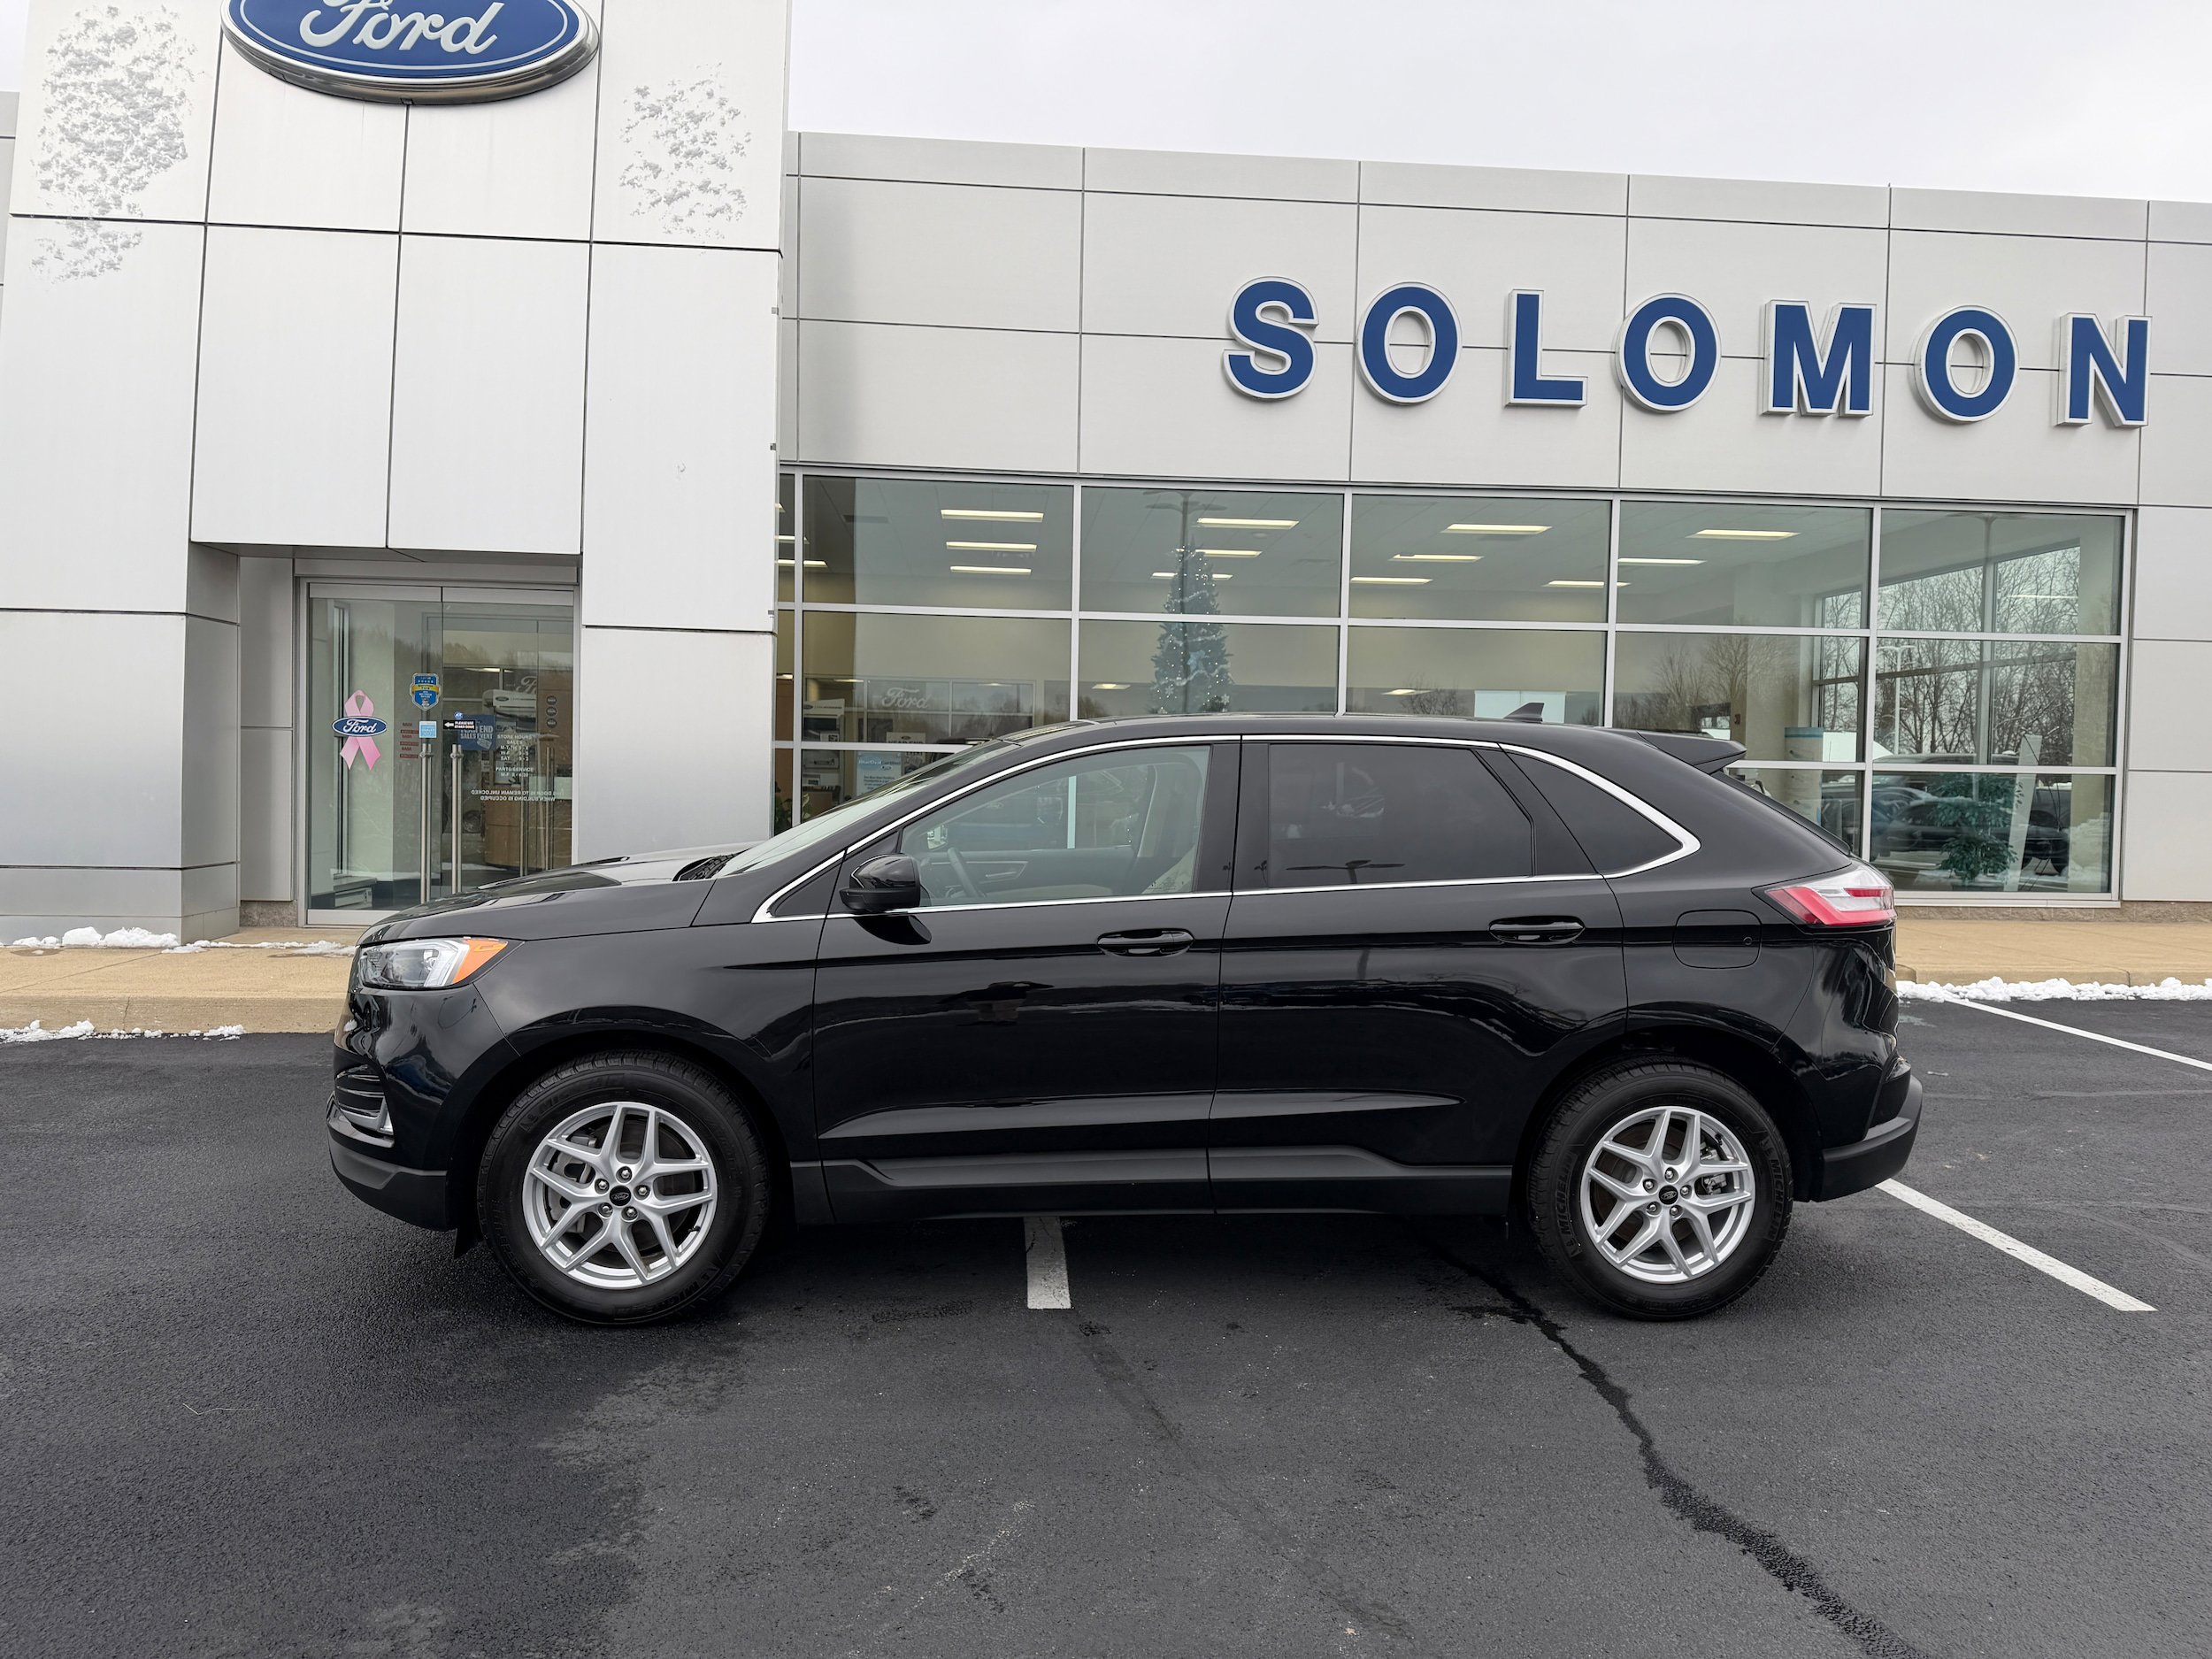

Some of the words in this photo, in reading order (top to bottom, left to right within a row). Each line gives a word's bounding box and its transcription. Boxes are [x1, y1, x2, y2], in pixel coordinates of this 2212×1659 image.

[299, 0, 505, 55] Ford
[1224, 276, 2153, 430] SOLOMON
[342, 718, 377, 733] Ford
[479, 725, 494, 733] END
[1555, 1152, 1578, 1235] MICHELIN
[1768, 1159, 1785, 1240] MICHELIN
